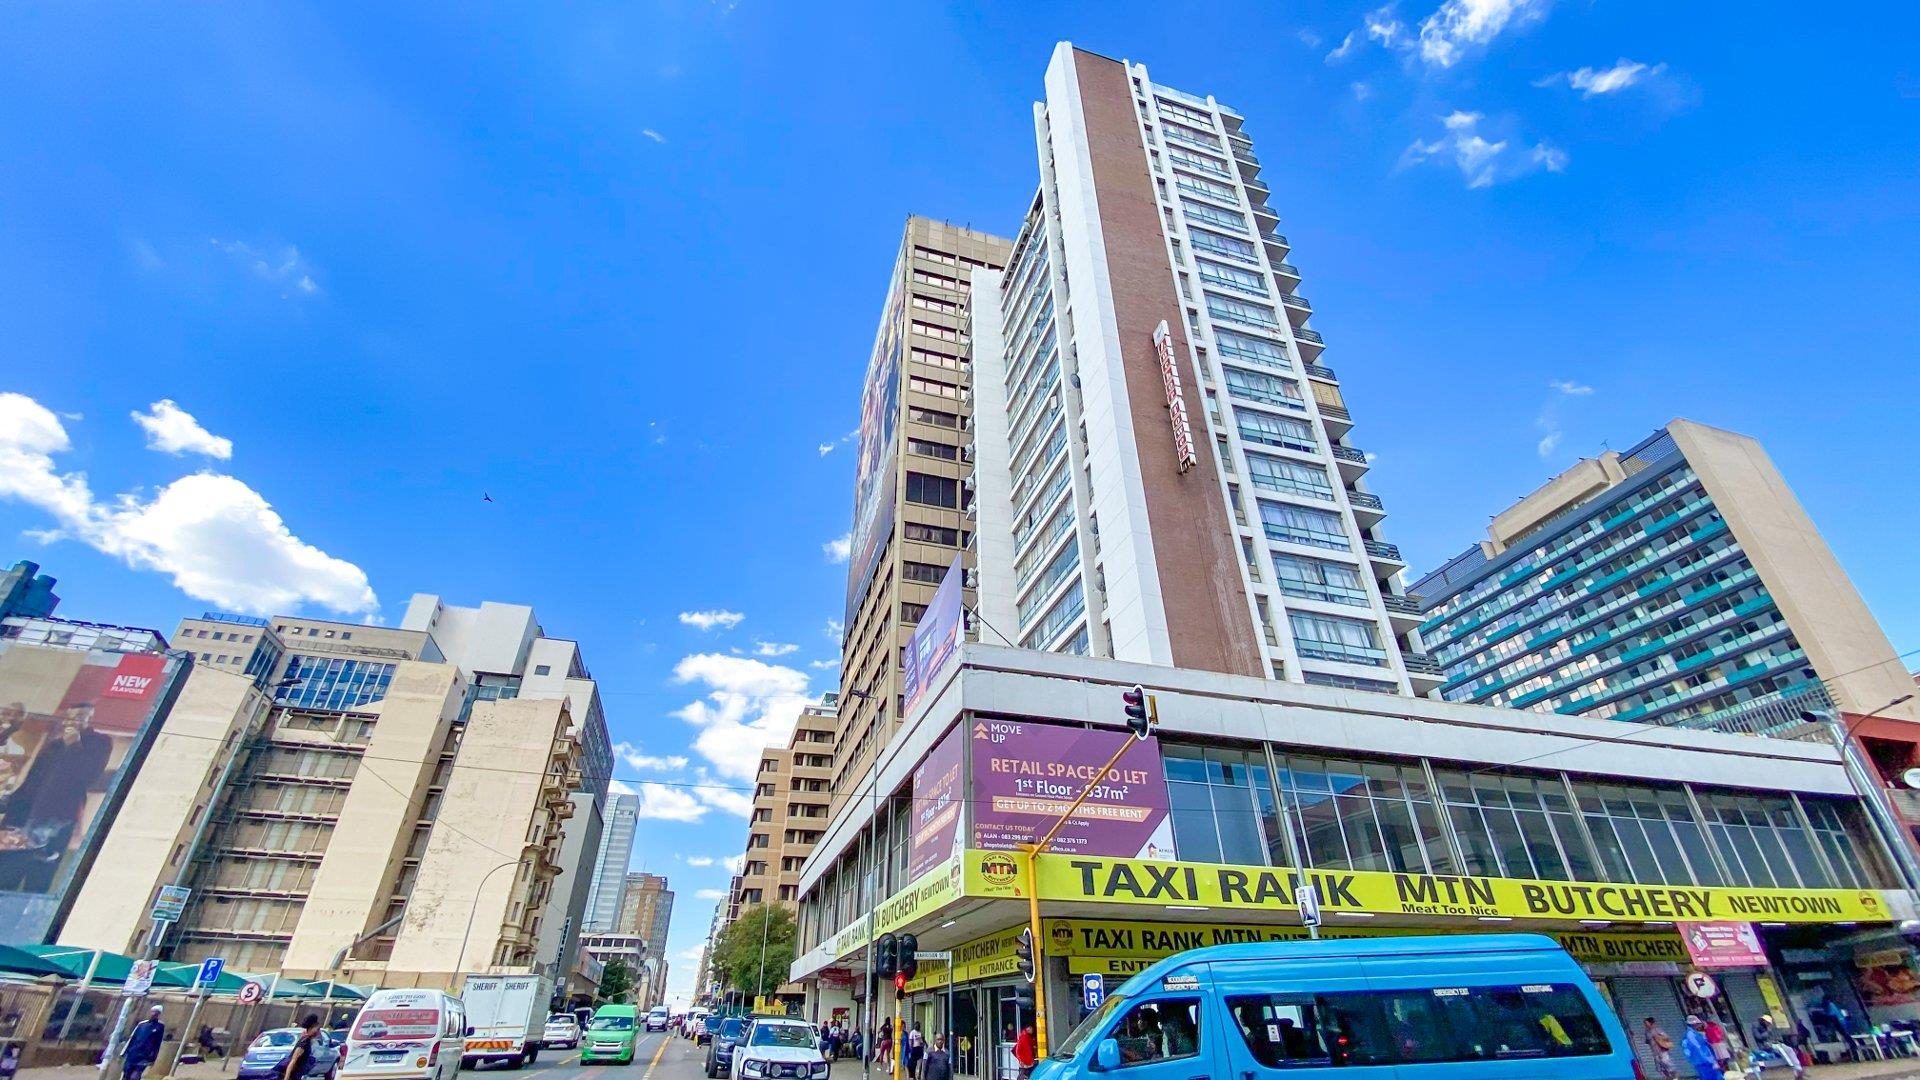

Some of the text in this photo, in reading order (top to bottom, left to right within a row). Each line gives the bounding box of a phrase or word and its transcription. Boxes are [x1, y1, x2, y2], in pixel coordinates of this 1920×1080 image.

[113, 675, 152, 688] NEW
[110, 686, 144, 694] FLAVOUR
[991, 724, 1022, 734] MOVE
[991, 734, 1005, 743] UP
[991, 758, 1044, 776] RETAIL
[1047, 763, 1095, 780] SPACE
[1123, 769, 1148, 785] LET
[1015, 779, 1032, 792] 1st
[1036, 780, 1072, 796] Floor
[996, 799, 1014, 809] GET
[1017, 801, 1029, 810] UP
[1032, 802, 1045, 811] TO
[1097, 807, 1118, 816] FREE
[1120, 808, 1142, 819] RENT
[982, 863, 1017, 875] MTN
[1070, 861, 1842, 917] TAXI RANK MTN BUTCHERY NEWTOWN
[881, 887, 920, 929] BUTCHERY
[921, 875, 950, 902] NEWTOWN
[1401, 903, 1499, 916] Meat Too Nice
[1052, 928, 1073, 939] MTN
[1081, 928, 1134, 950] TAXI
[1142, 930, 1204, 950] RANK
[1212, 928, 1263, 945] MTN
[962, 938, 1000, 963] BUTCHERY
[1560, 935, 1685, 957] MTN BUTCHERY
[208, 961, 218, 970] P
[979, 959, 1014, 976] ENTRANCE
[472, 981, 530, 990] SHERIFF SHERIFF
[1089, 992, 1099, 1007] R
